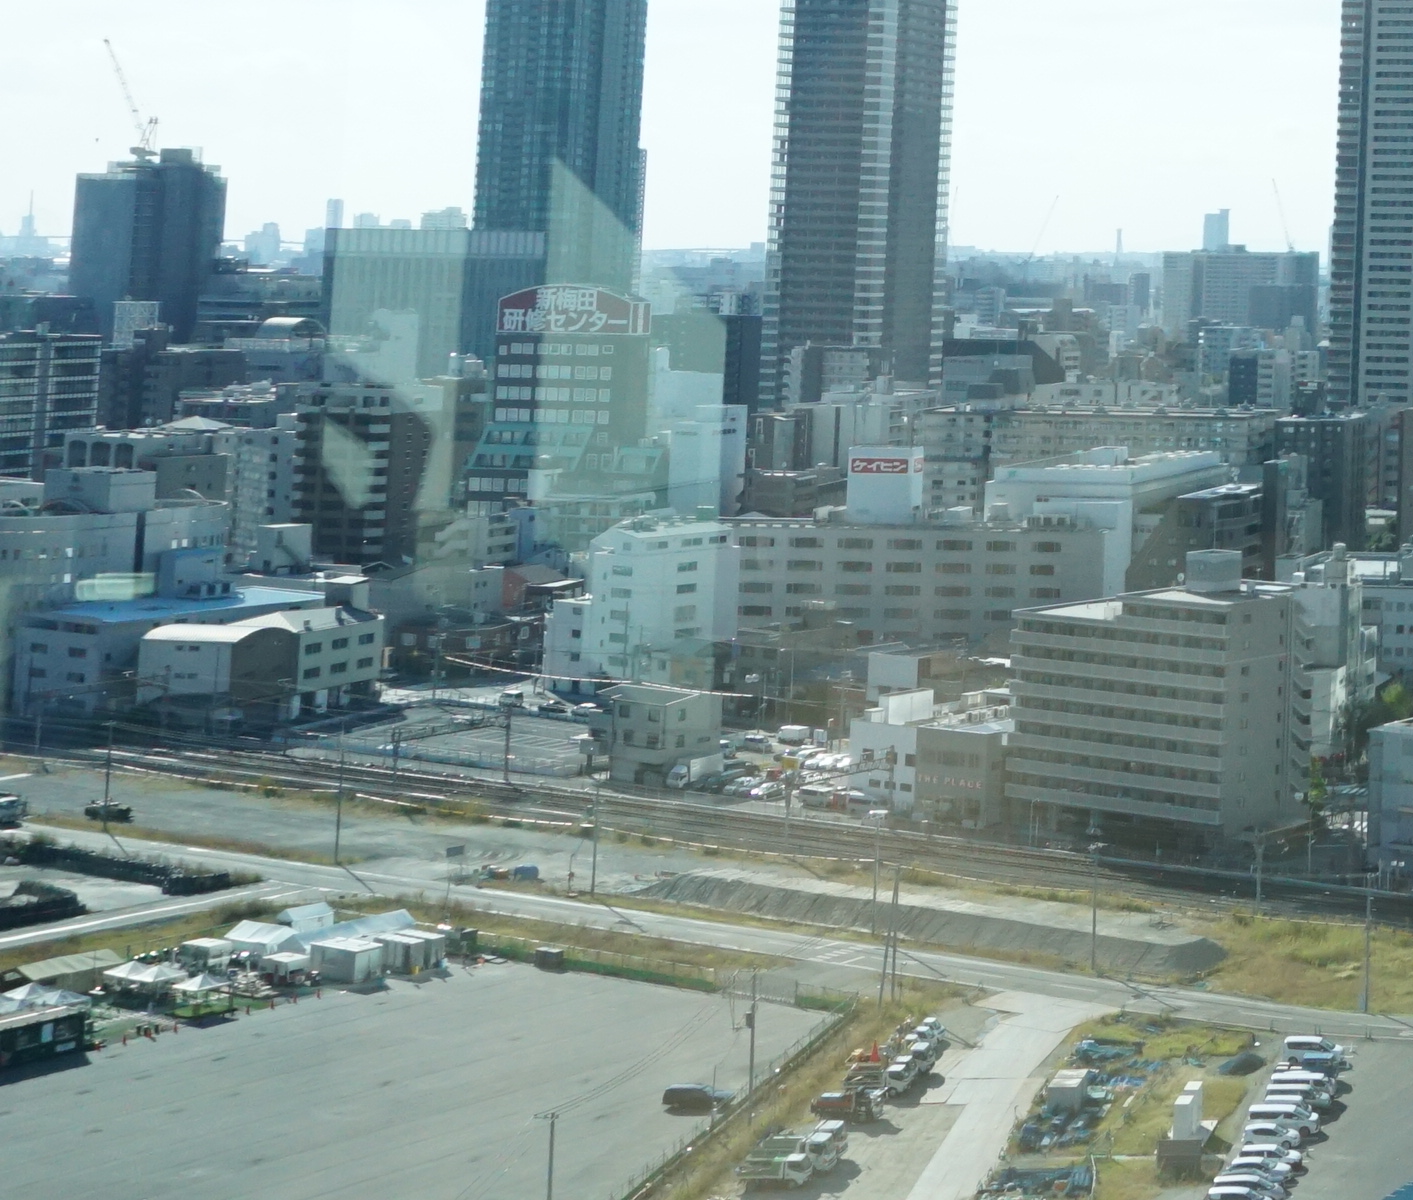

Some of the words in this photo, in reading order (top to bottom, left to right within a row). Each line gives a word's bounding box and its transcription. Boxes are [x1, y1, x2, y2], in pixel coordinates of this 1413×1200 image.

[536, 288, 598, 311] 新梅田
[503, 308, 628, 332] 研修センター
[853, 460, 907, 472] ケイヒン
